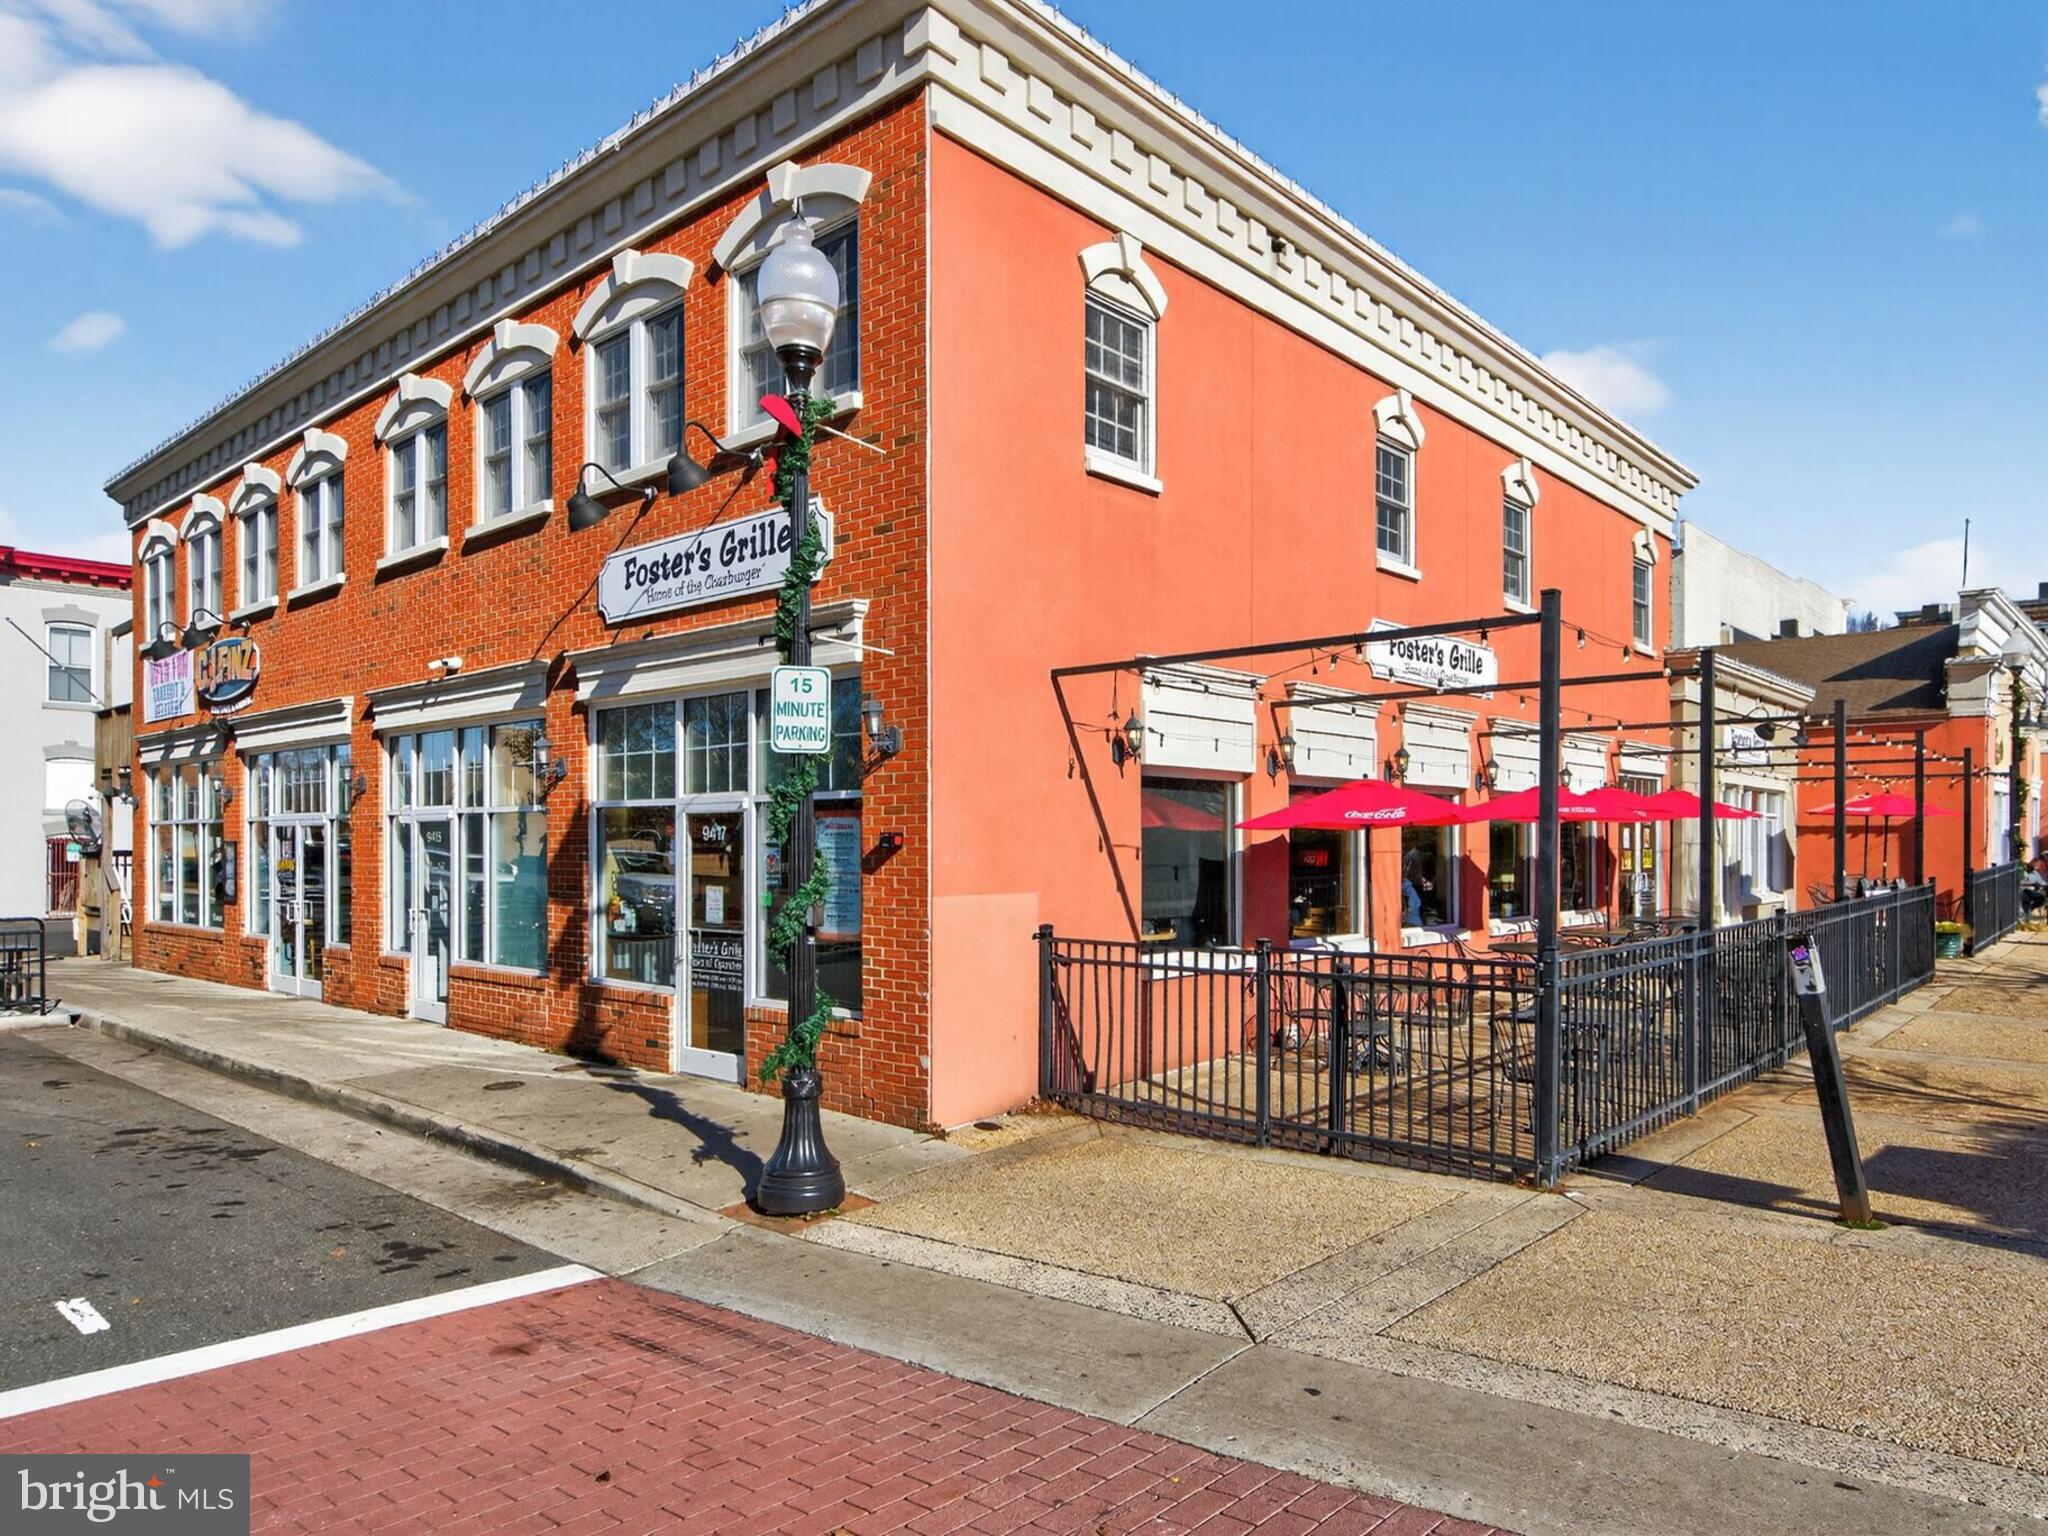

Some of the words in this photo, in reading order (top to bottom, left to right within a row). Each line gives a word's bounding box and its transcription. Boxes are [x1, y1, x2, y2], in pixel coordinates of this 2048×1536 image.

[624, 540, 711, 590] Foster's
[719, 519, 792, 567] Grille
[1389, 639, 1444, 667] Foster's
[1449, 644, 1483, 675] Grille
[790, 678, 813, 693] 15
[776, 701, 826, 718] MINUTE
[776, 725, 826, 742] PARKING
